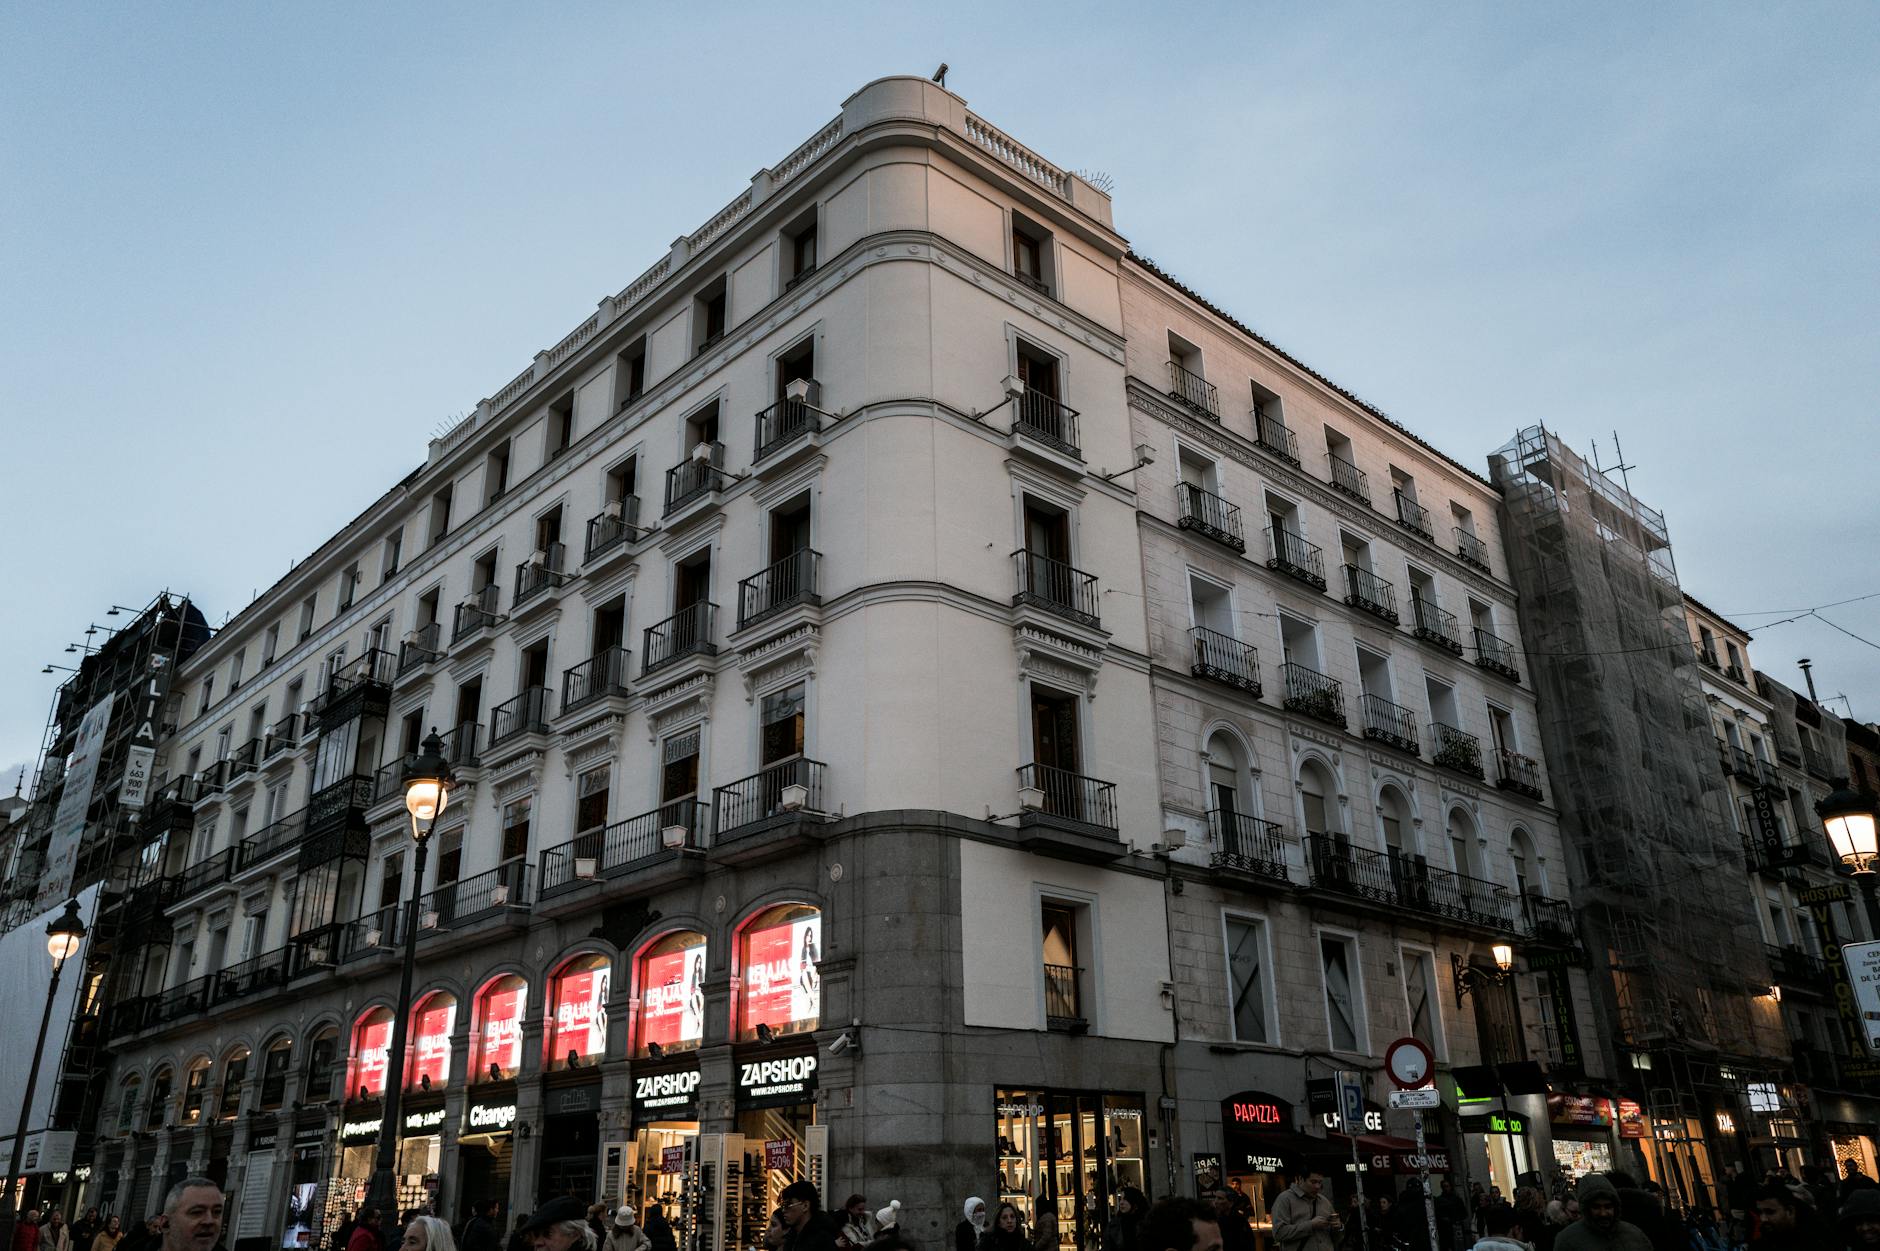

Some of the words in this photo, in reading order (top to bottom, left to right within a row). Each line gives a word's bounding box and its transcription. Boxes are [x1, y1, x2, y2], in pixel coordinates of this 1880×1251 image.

[129, 770, 144, 778] 663
[128, 778, 143, 788] 900
[126, 788, 139, 797] 991
[1799, 884, 1849, 904] HOSTAL
[1813, 904, 1866, 1059] VICTORIA
[741, 1056, 817, 1086] ZAPSHOP
[635, 1071, 701, 1099] ZAPSHOP
[750, 1083, 803, 1097] WWW.ZAPSHOP.ES
[1000, 1103, 1044, 1117] ZAPSHOP
[1345, 1089, 1357, 1118] P
[469, 1105, 516, 1127] Change
[1233, 1103, 1280, 1123] PAPIZZA
[766, 1140, 791, 1150] REBAJAS
[772, 1147, 786, 1156] SALE
[667, 1153, 681, 1161] SALE
[768, 1155, 791, 1169] -50%
[1247, 1155, 1283, 1168] PAPIZZA
[1408, 1154, 1449, 1169] CHNGE
